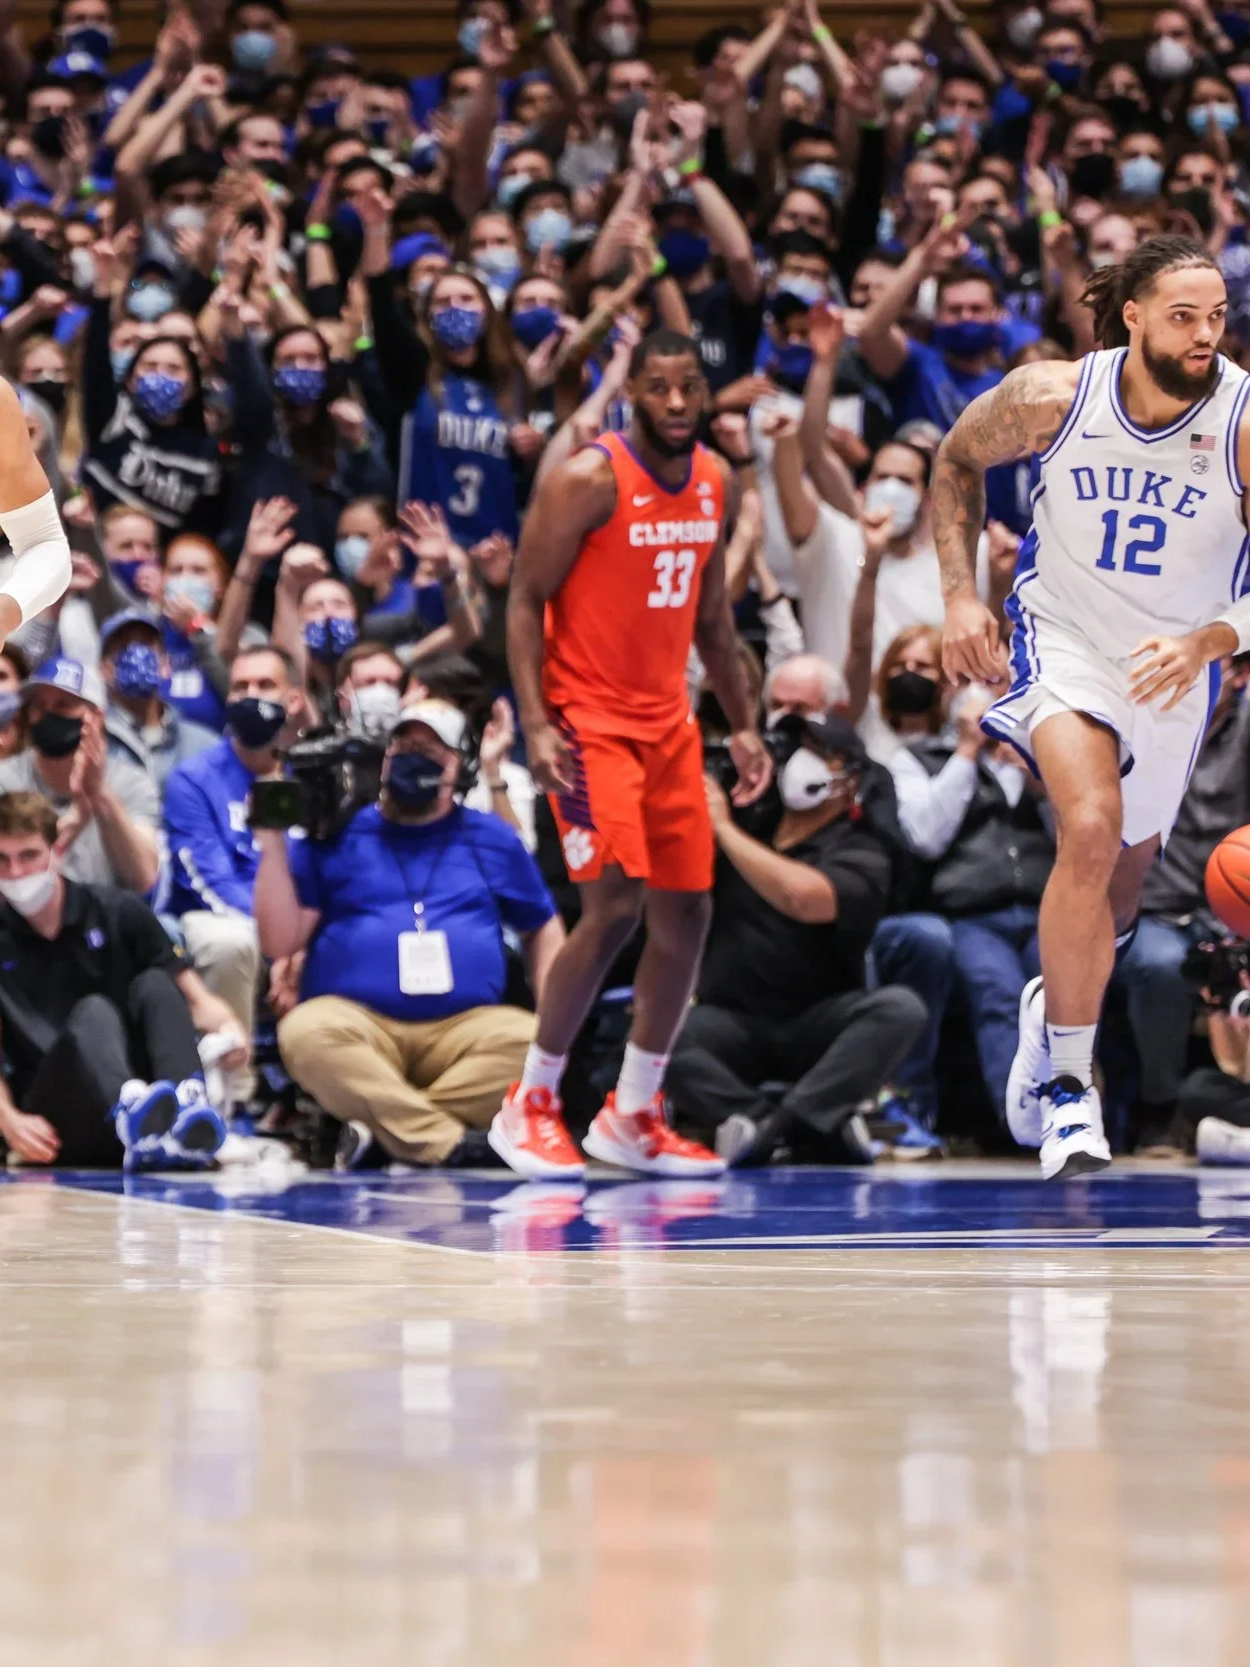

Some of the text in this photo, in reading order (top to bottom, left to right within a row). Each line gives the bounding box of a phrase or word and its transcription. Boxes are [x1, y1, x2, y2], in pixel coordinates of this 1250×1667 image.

[438, 411, 508, 459] DUKE
[448, 465, 482, 516] 3
[1070, 466, 1208, 519] DUKE
[630, 521, 718, 546] CLEMSON
[1095, 509, 1167, 576] 12
[647, 549, 696, 607] 33
